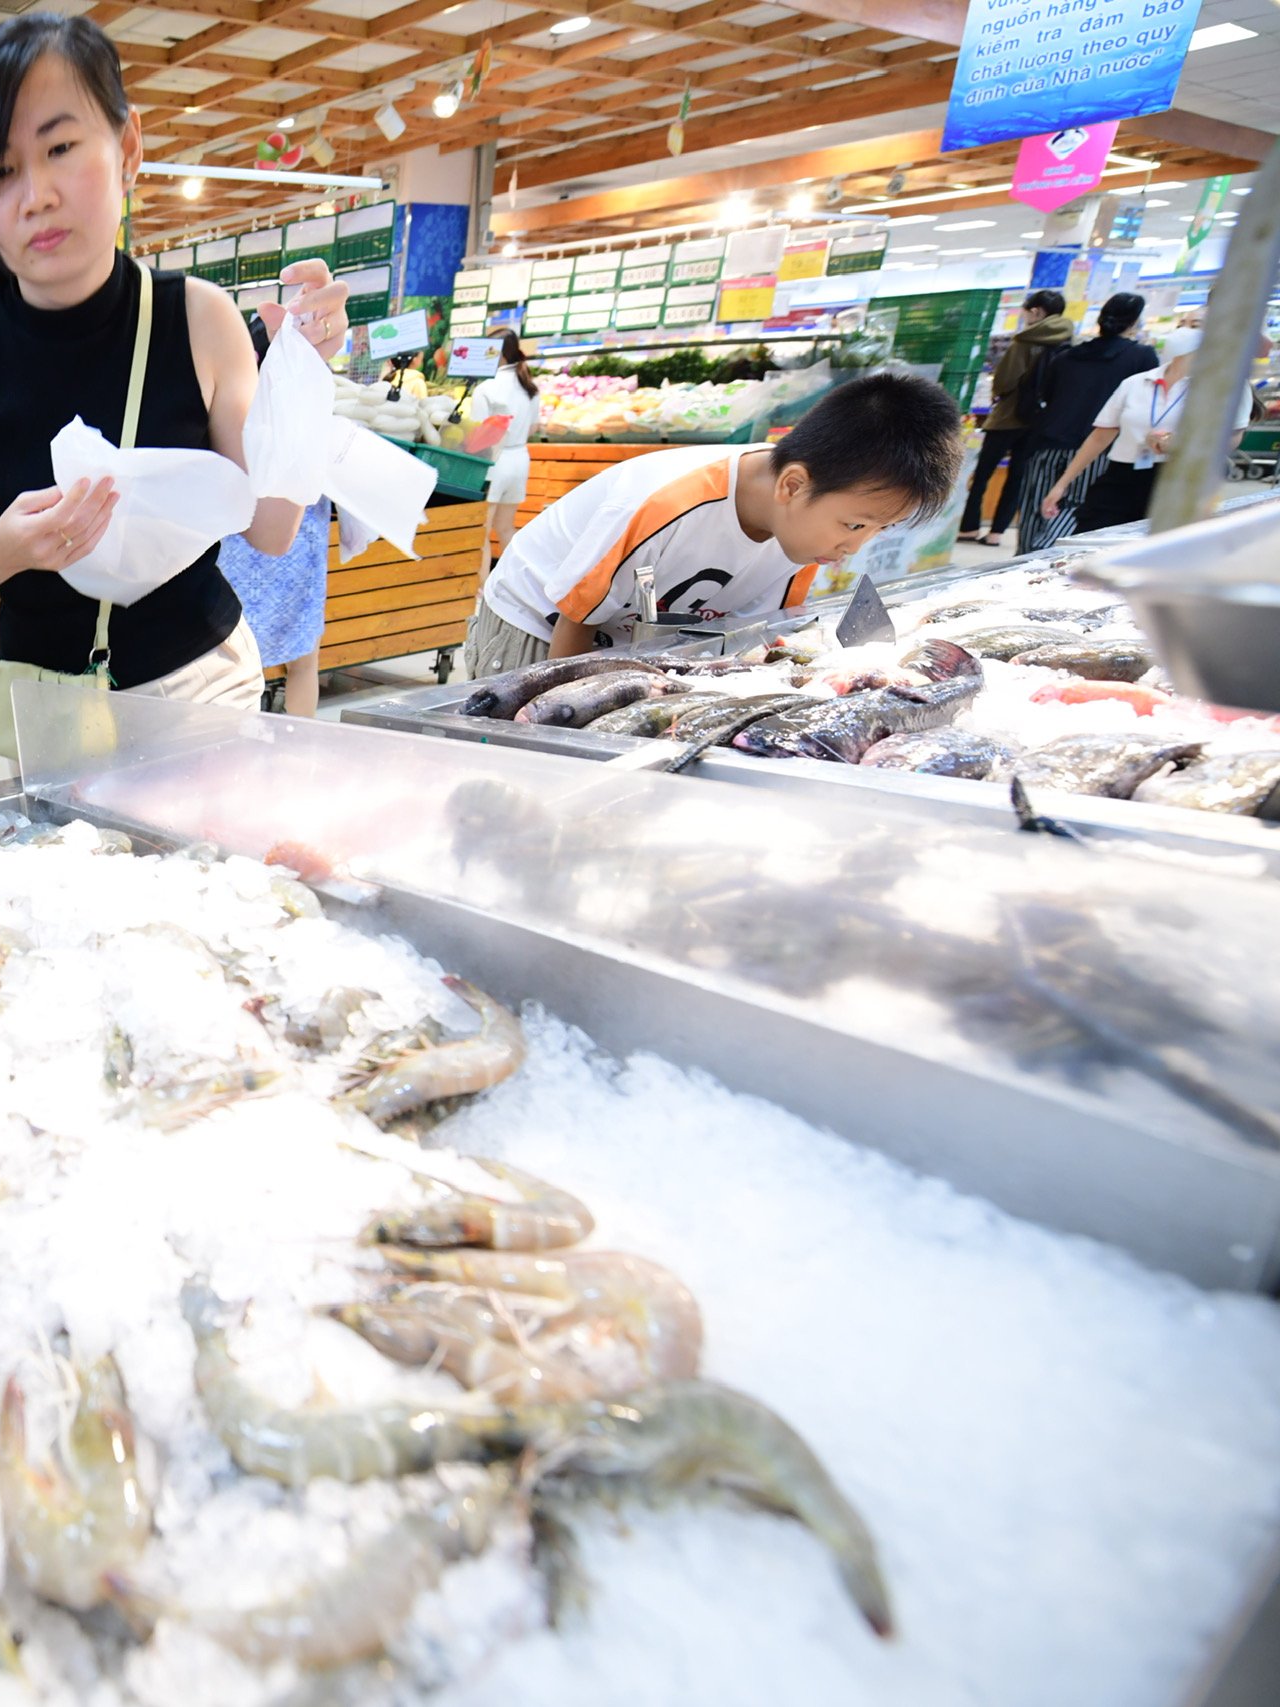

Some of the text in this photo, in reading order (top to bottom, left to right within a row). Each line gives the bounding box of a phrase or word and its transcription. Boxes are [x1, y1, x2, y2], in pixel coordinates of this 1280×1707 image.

[976, 36, 1020, 58] kiểm
[1037, 28, 1063, 44] tra
[1079, 12, 1124, 33] đảm
[982, 8, 1041, 35] nguồn
[971, 24, 1177, 82] chất lượng theo quy
[966, 84, 1005, 105] định
[1011, 76, 1046, 95] của
[1052, 65, 1091, 86] Nhà
